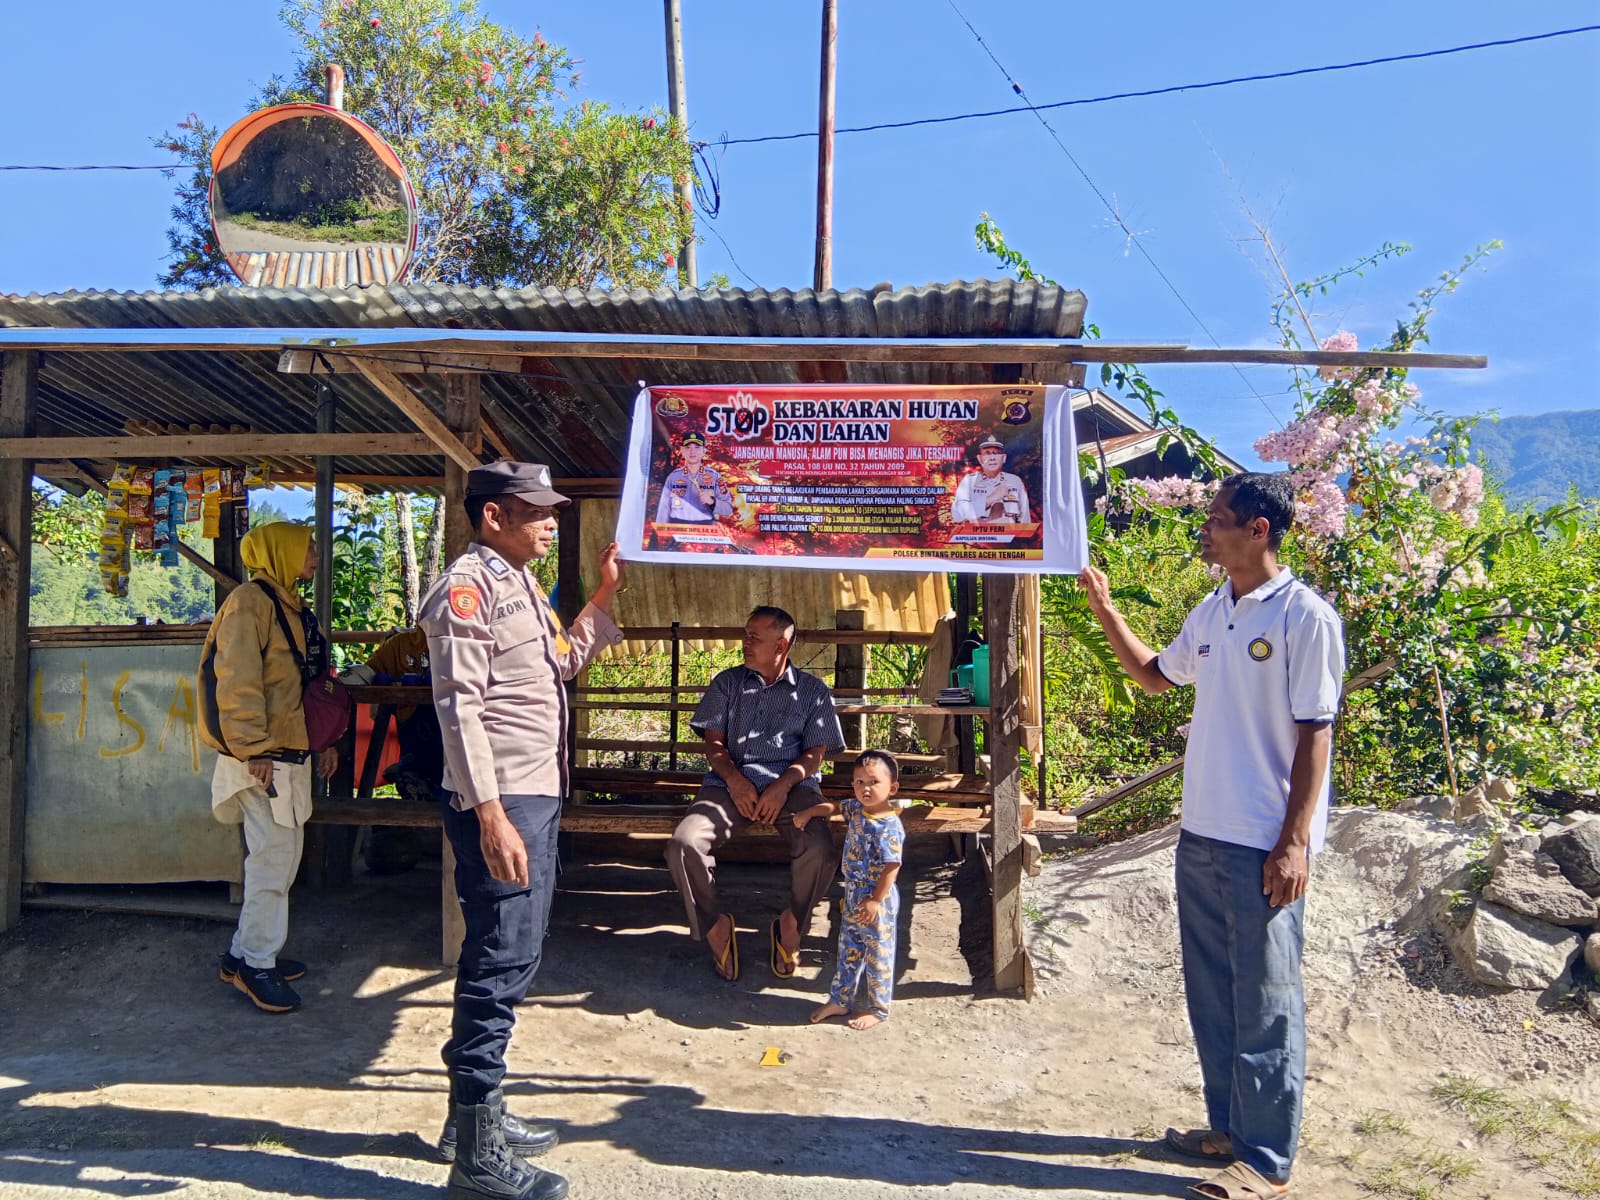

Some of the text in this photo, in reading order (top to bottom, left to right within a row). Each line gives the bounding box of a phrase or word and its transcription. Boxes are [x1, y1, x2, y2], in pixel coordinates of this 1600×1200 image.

[773, 400, 977, 419] KEBAKARAN HUTAN
[706, 405, 768, 434] STOP
[773, 423, 889, 441] DAN LAHAN
[812, 447, 831, 460] ALAM
[834, 447, 848, 460] PUN
[850, 447, 865, 460] BISA
[868, 447, 904, 460] MENANGIS
[906, 448, 922, 460] JIKA
[496, 599, 527, 618] RONI
